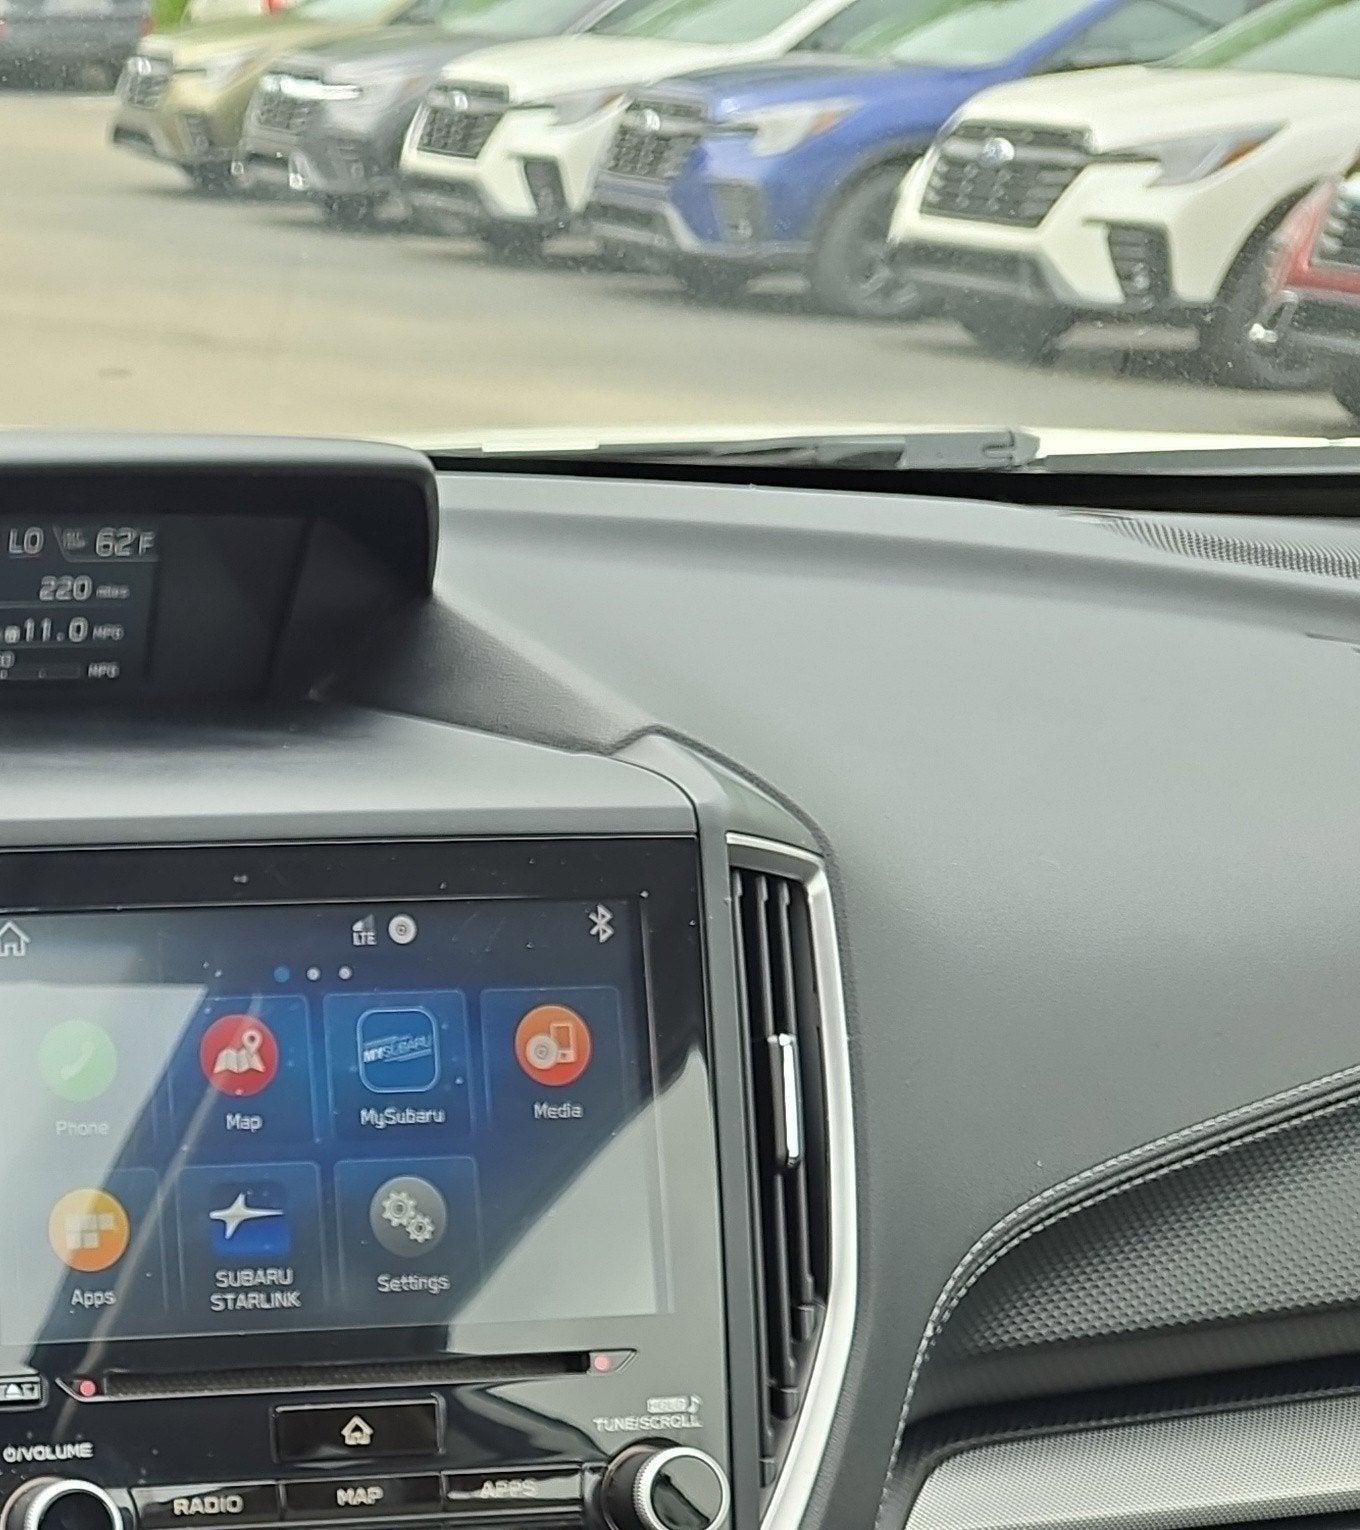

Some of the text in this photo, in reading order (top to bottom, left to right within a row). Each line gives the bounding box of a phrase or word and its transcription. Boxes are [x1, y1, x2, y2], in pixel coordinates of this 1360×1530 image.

[8, 527, 45, 556] LO
[39, 575, 93, 601] 220
[23, 616, 89, 643] 11.0
[353, 931, 378, 946] LTE
[360, 1106, 446, 1130] MySubaru
[533, 1101, 584, 1120] Media
[55, 1120, 110, 1137] Phone
[226, 1112, 264, 1132] Map
[214, 1267, 294, 1288] SUBARU
[377, 1273, 451, 1295] Settings
[70, 1288, 117, 1309] Apps
[210, 1290, 303, 1312] STARLINK
[592, 1412, 704, 1433] TUNE/SCROLL
[336, 1486, 385, 1507] MAP
[480, 1478, 539, 1500] APPS
[173, 1494, 245, 1517] RADIO
